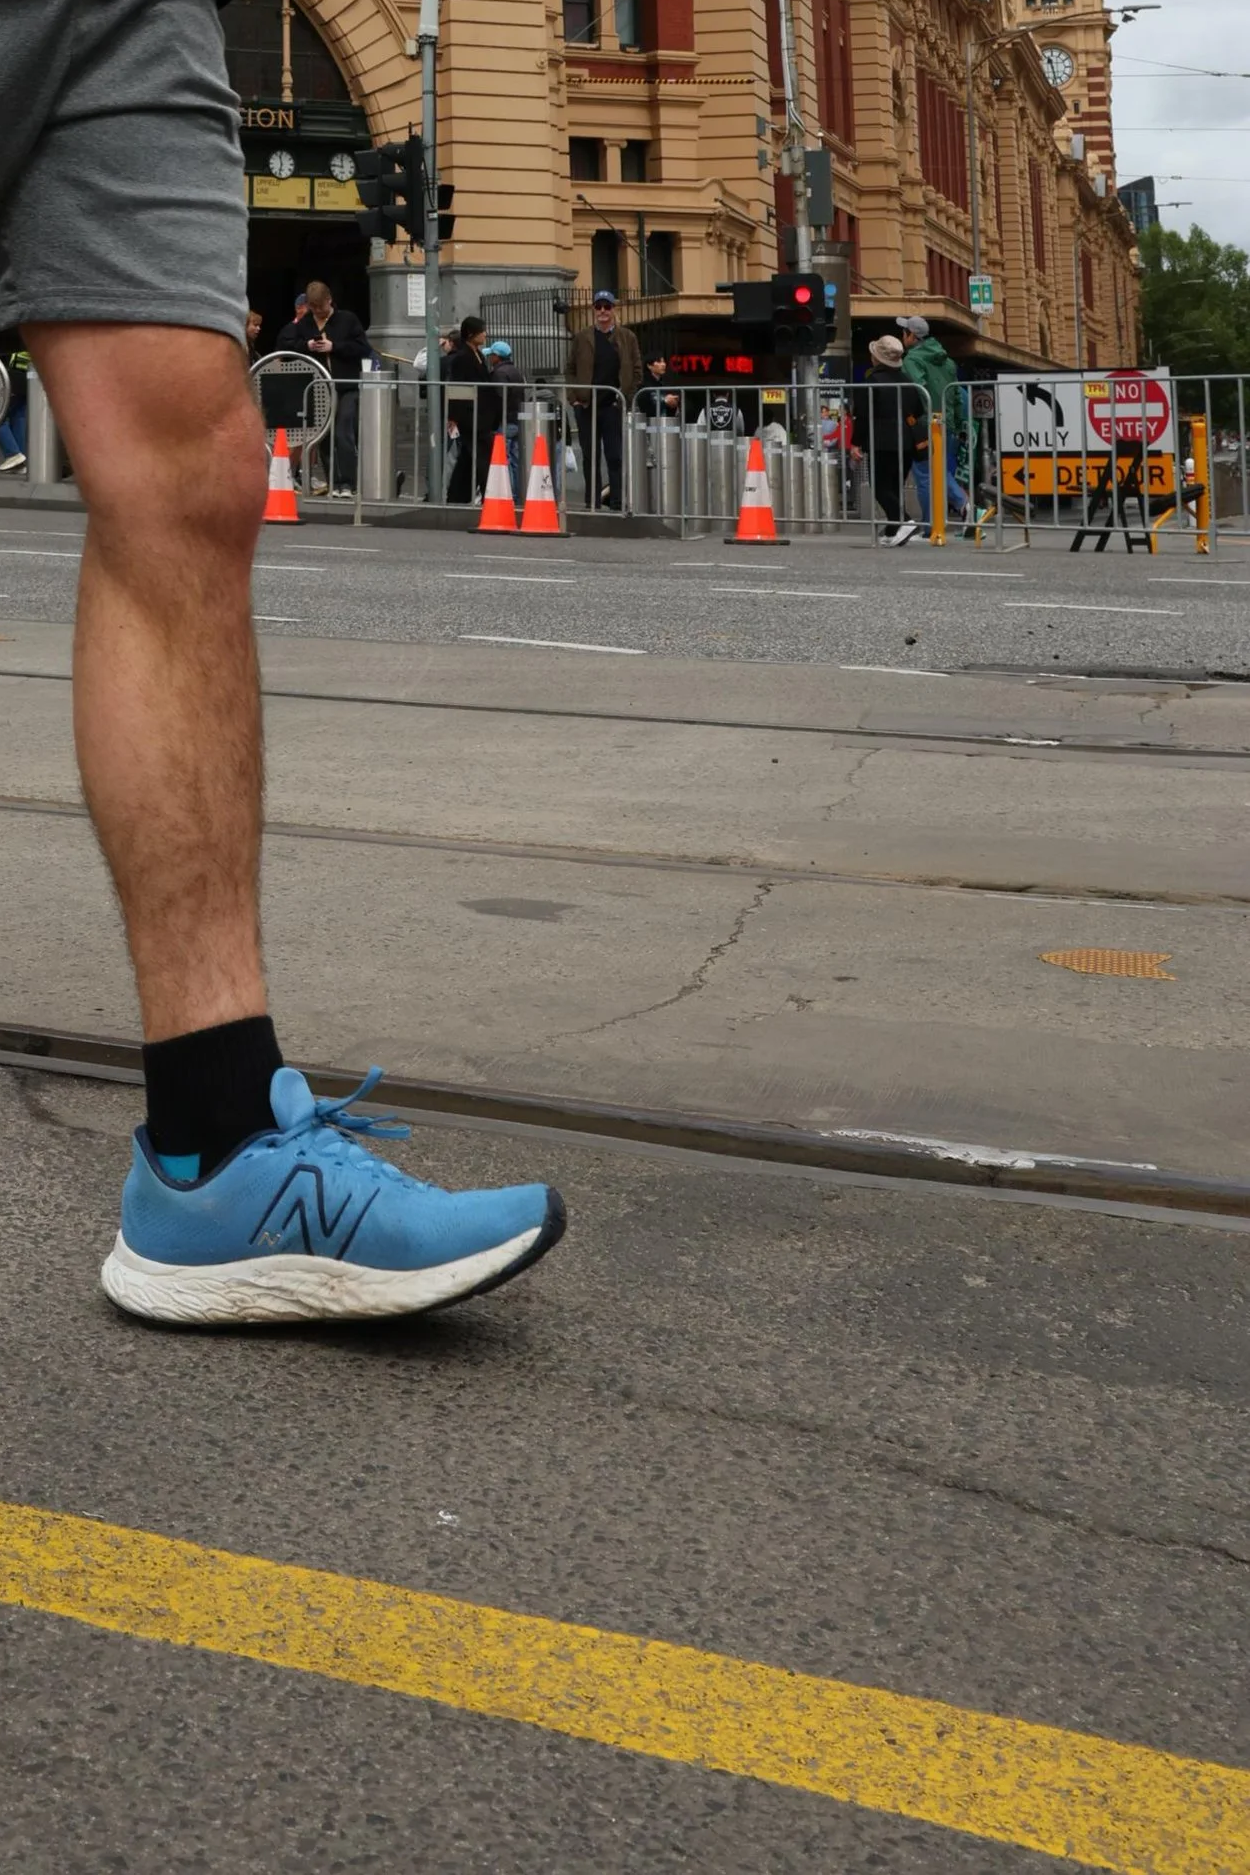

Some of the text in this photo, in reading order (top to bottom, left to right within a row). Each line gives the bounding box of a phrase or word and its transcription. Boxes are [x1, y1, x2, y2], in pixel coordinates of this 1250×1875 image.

[240, 108, 294, 129] ION
[670, 354, 713, 373] CITY
[1115, 383, 1139, 400] NO
[1101, 421, 1159, 438] ENTRY
[1013, 431, 1069, 447] ONLY
